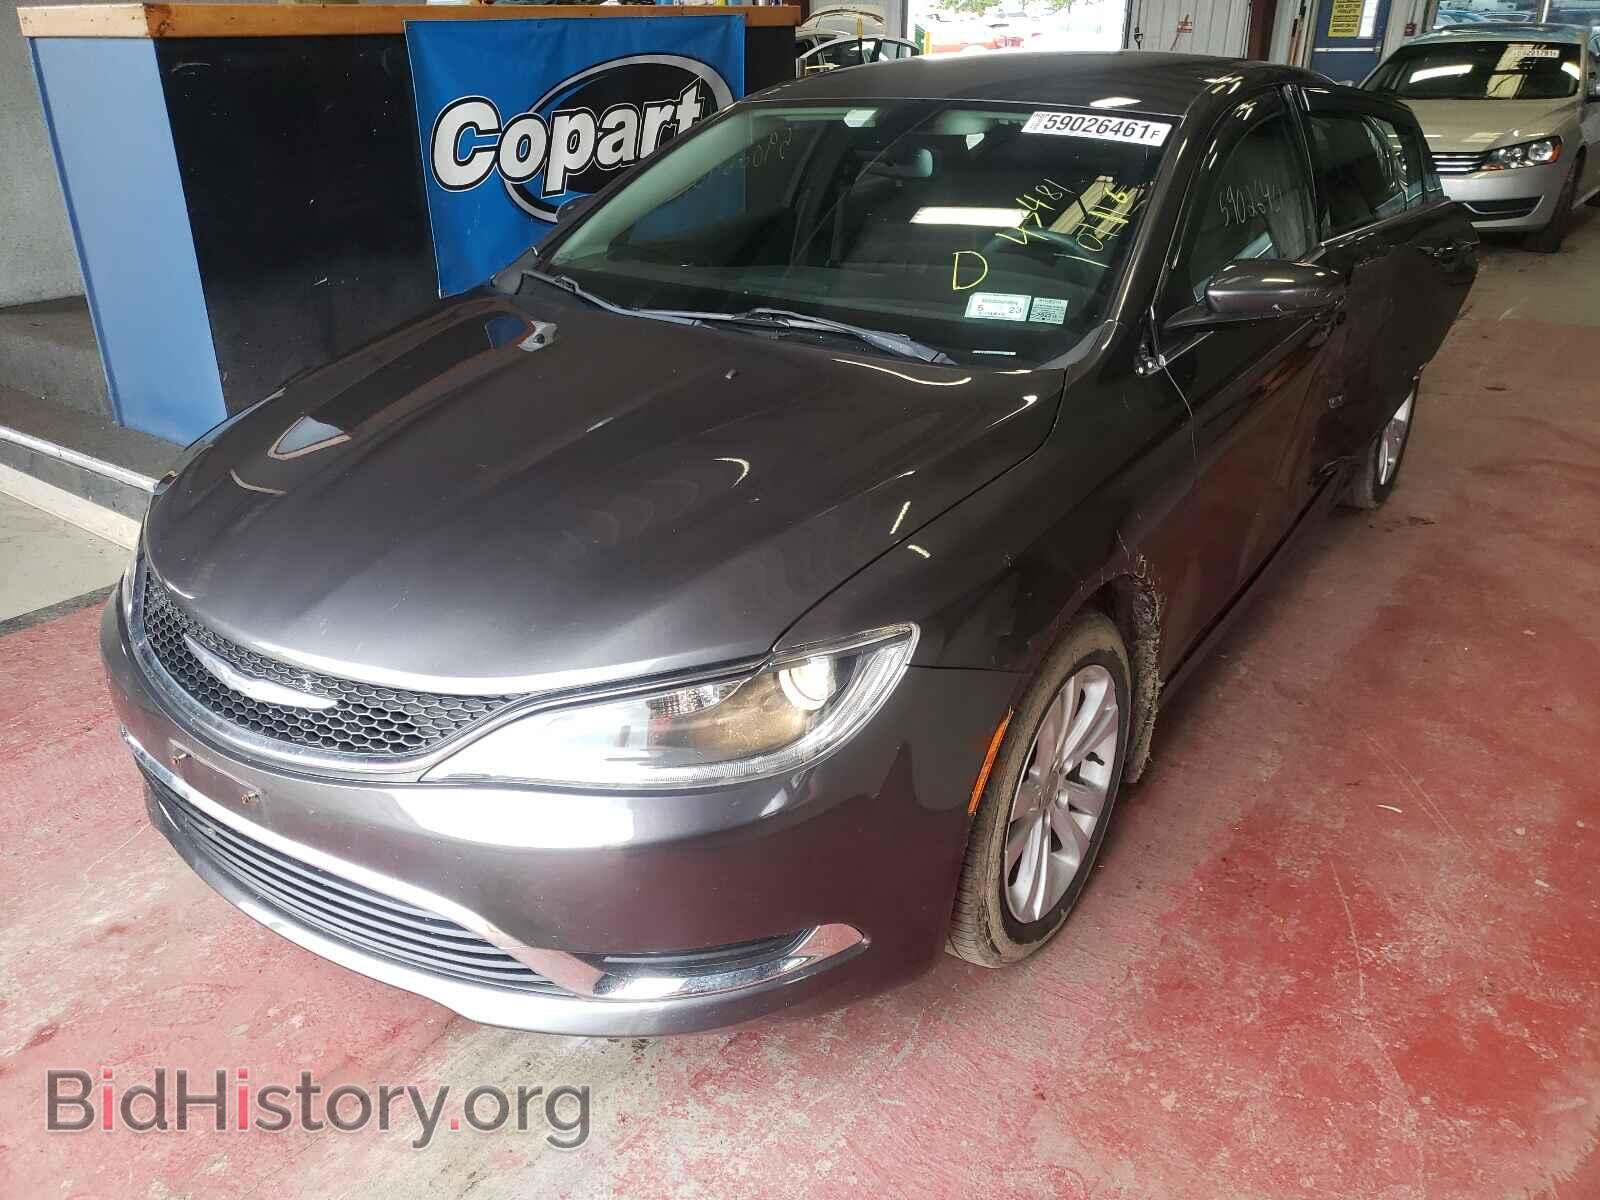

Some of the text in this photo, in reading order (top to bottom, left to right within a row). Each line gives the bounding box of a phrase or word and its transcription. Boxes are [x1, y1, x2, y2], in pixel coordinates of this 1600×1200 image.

[431, 76, 704, 198] Copart
[1044, 114, 1151, 139] 59026461
[952, 250, 988, 290] D
